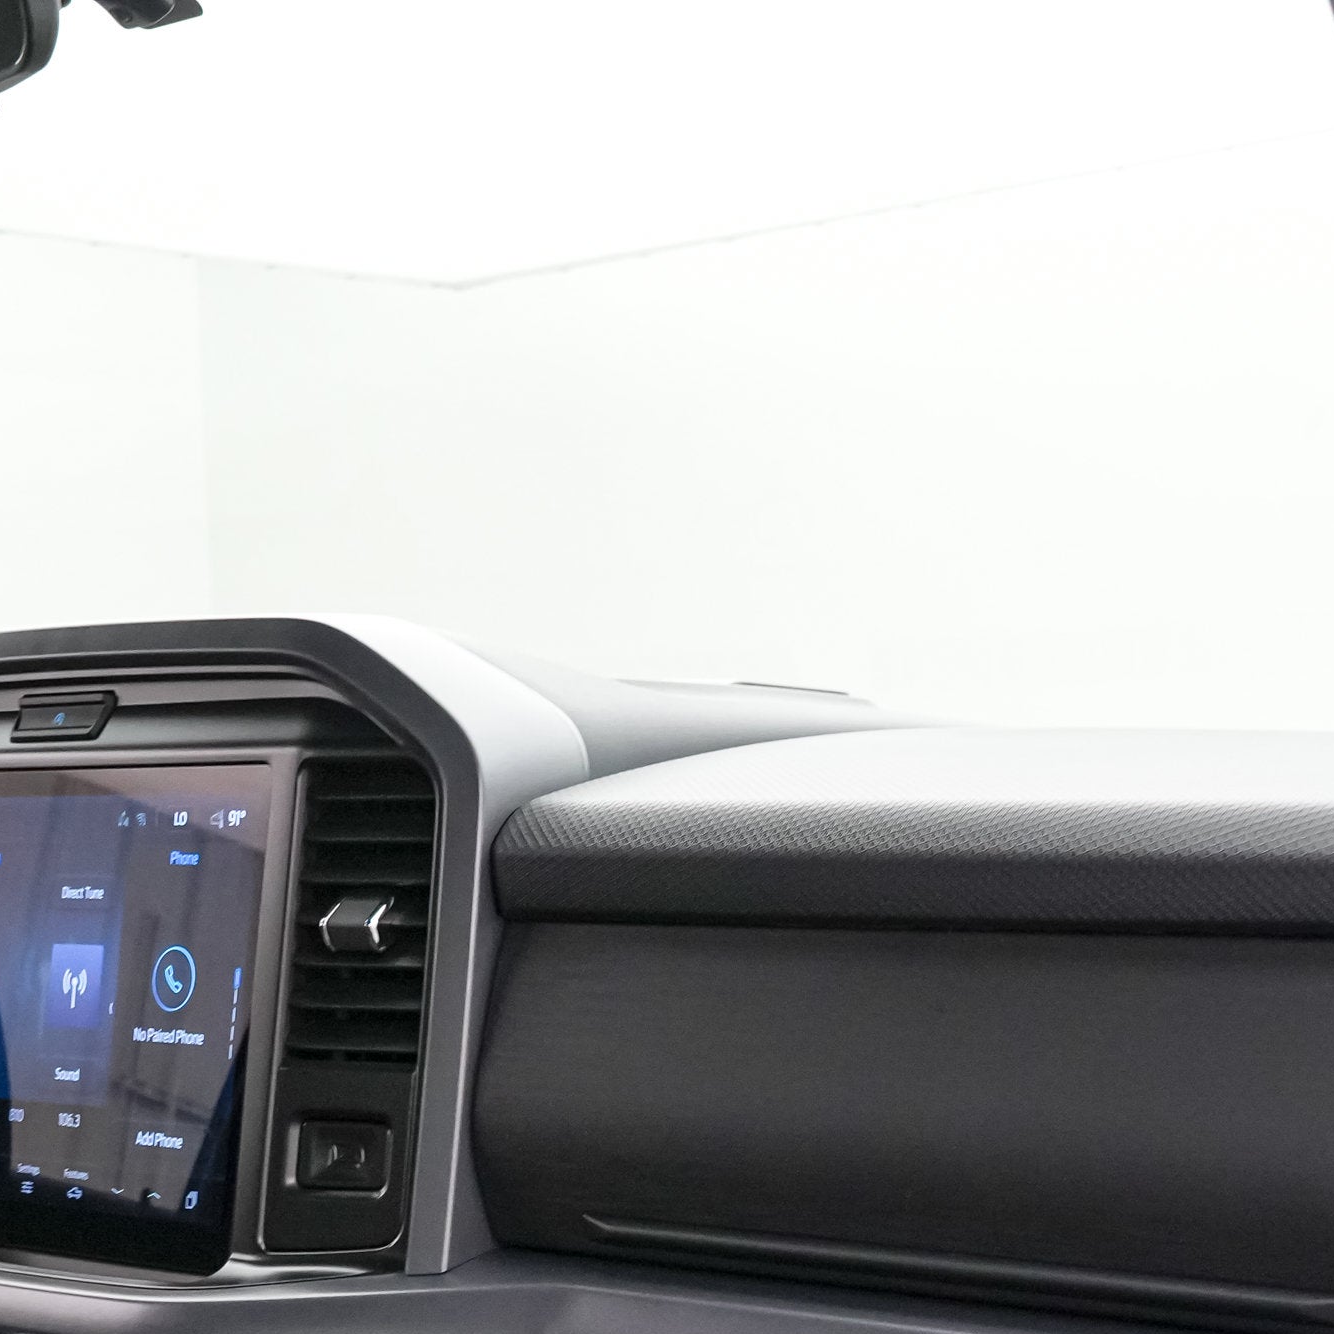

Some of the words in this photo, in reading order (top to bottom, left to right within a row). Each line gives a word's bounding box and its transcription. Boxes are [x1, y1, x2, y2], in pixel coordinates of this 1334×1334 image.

[173, 811, 188, 827] LO
[169, 850, 200, 866] Phone
[61, 886, 85, 899] Direct
[85, 886, 105, 900] Tune
[132, 1027, 146, 1042] No
[147, 1027, 175, 1044] Paired
[175, 1029, 205, 1046] Phone
[54, 1067, 81, 1082] Sound
[135, 1130, 154, 1147] Add
[154, 1132, 184, 1150] Phone
